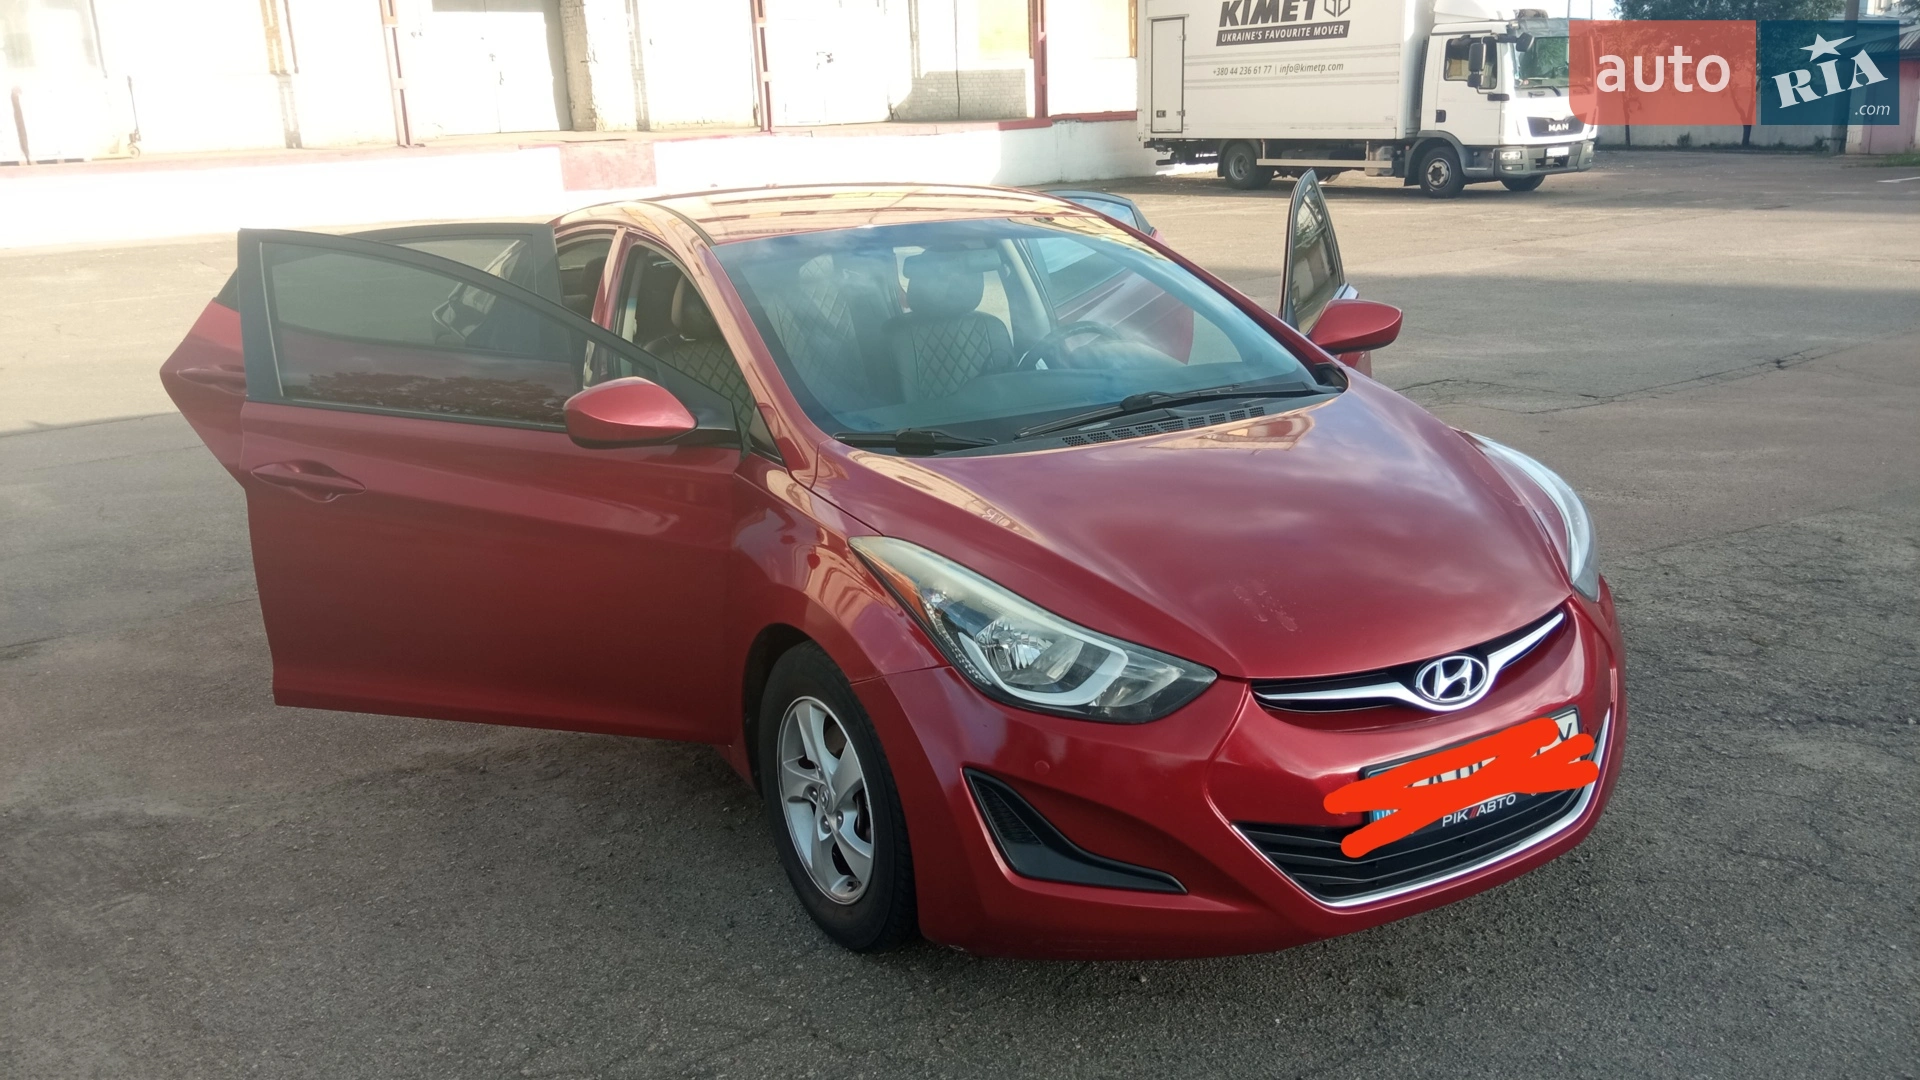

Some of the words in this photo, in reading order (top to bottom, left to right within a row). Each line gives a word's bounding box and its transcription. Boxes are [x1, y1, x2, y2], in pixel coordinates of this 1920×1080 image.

[1219, 0, 1316, 27] KIMET
[1221, 30, 1263, 42] UKRAINE'S
[1264, 27, 1311, 40] FAVOURITE
[1313, 25, 1344, 36] MOVER
[1213, 67, 1228, 76] +380
[1229, 67, 1238, 75] 44
[1239, 66, 1252, 75] 236
[1253, 65, 1261, 74] 61
[1263, 65, 1272, 74] 77
[1279, 63, 1344, 75] info@kimetp.com
[1548, 123, 1569, 132] MAN
